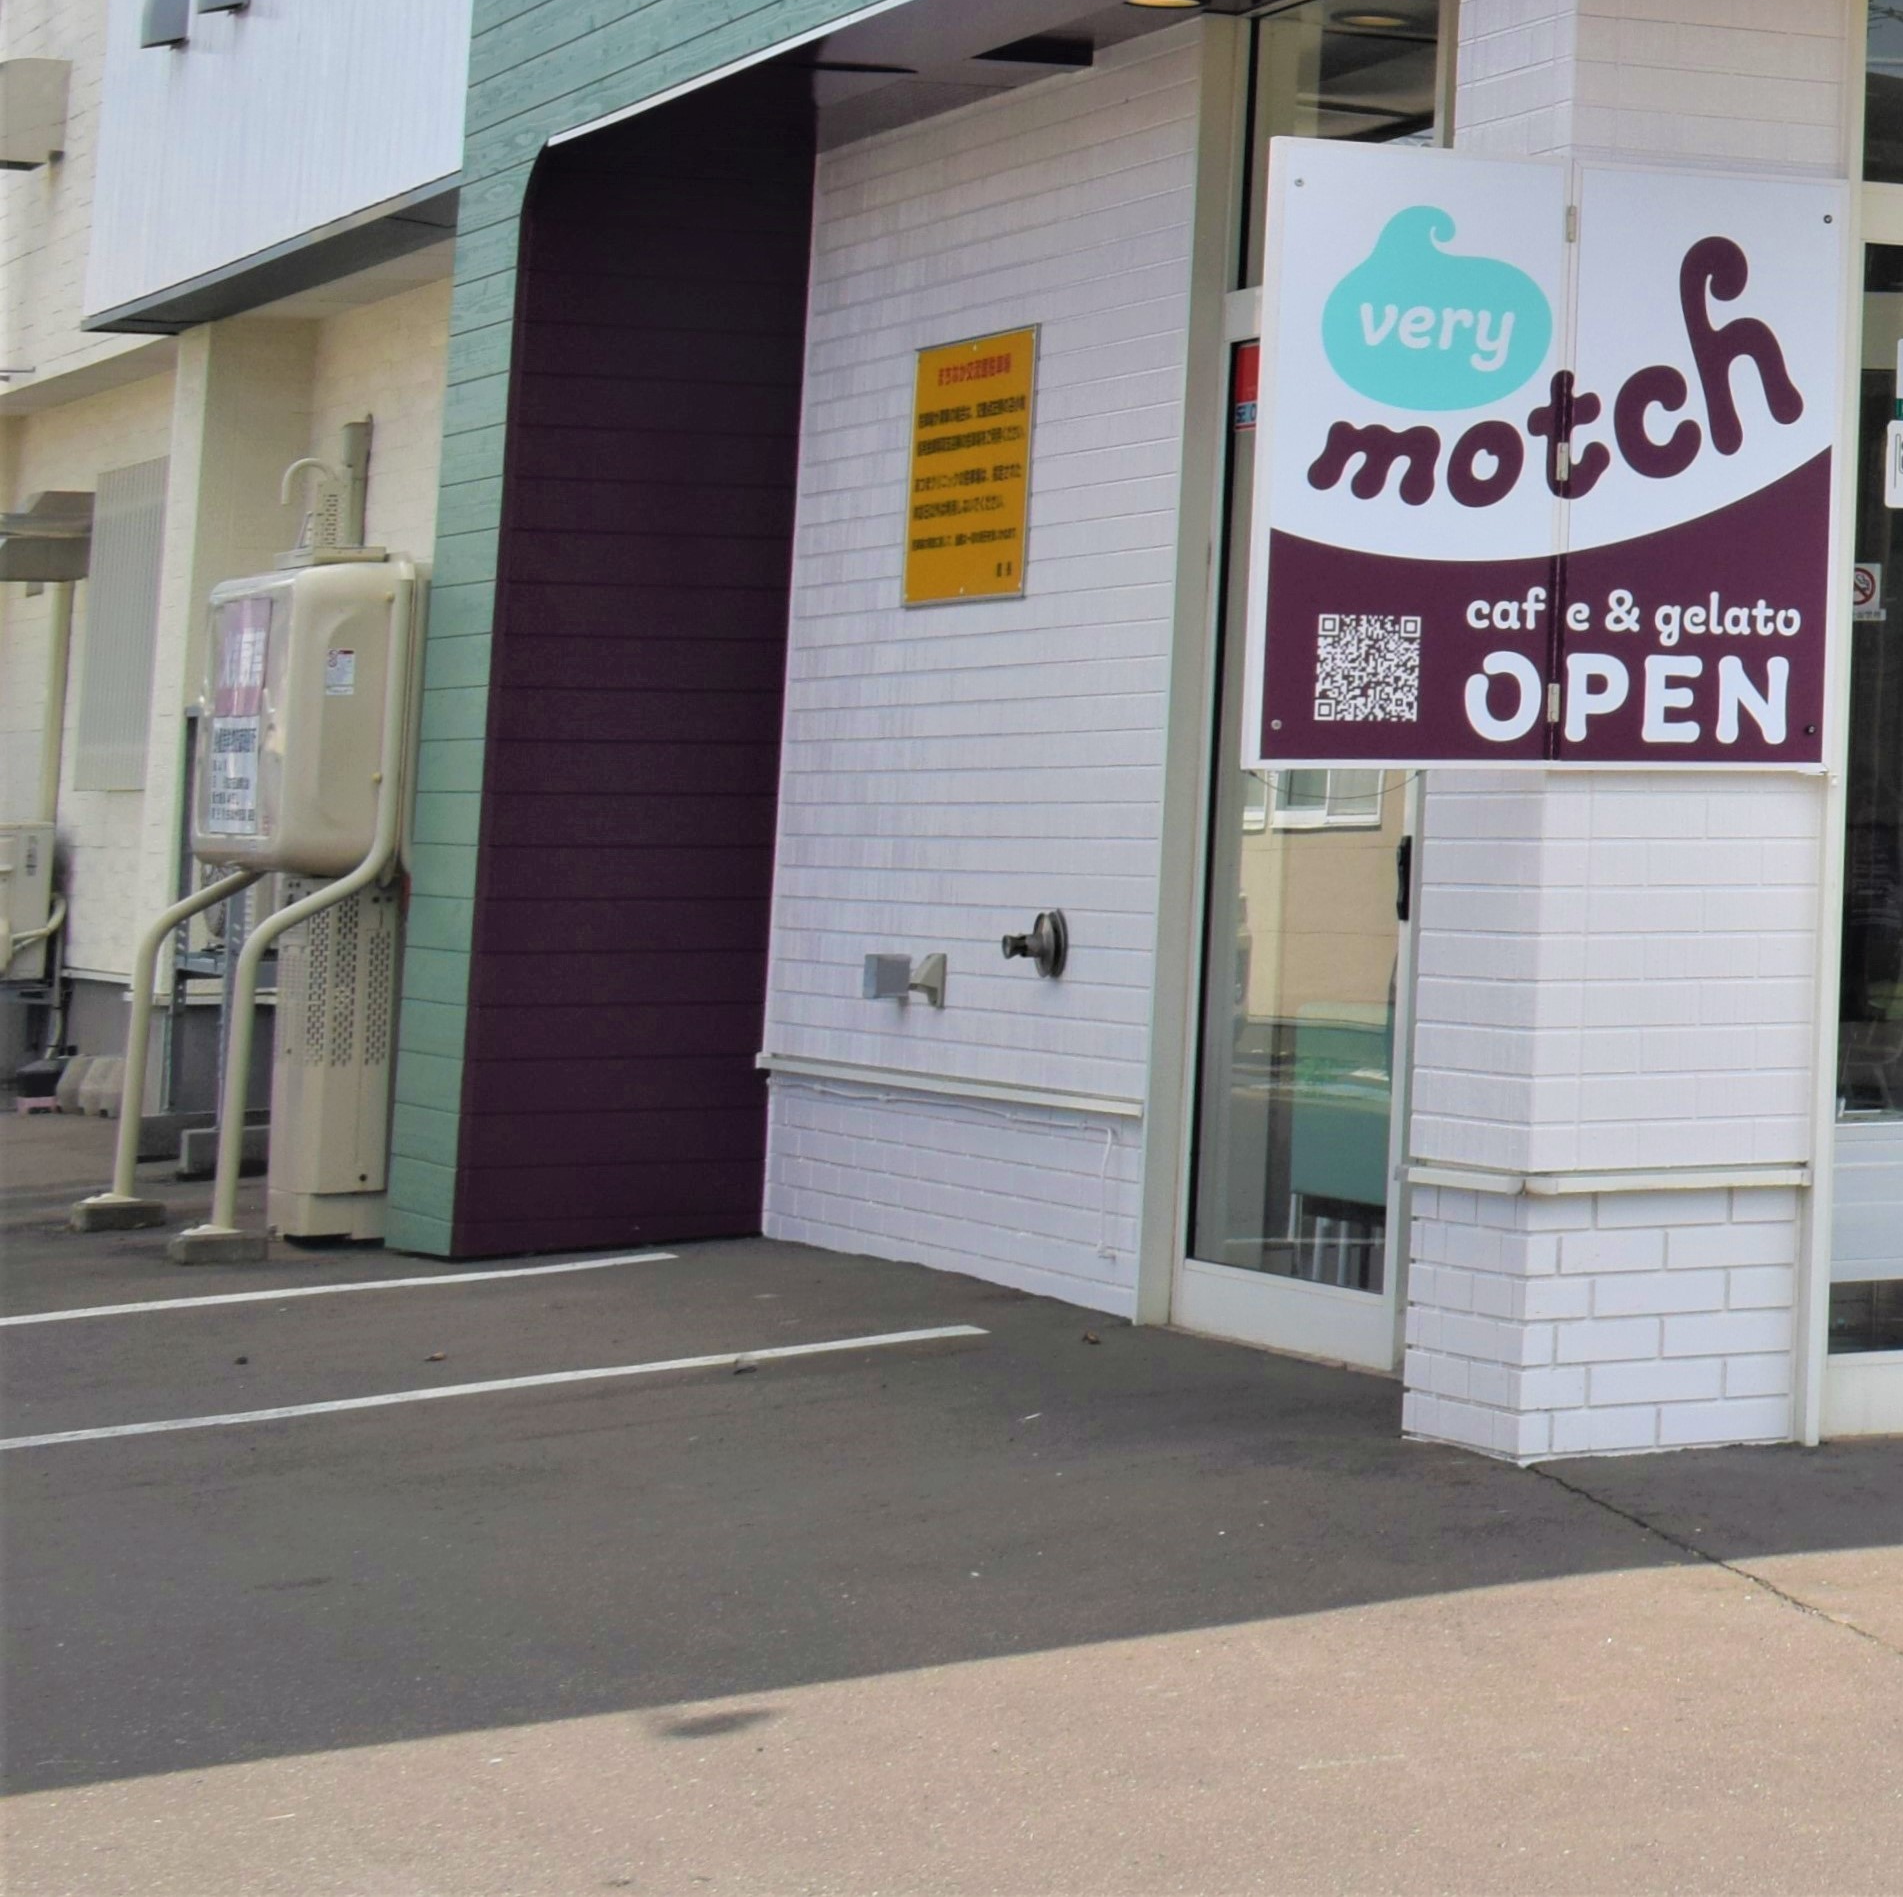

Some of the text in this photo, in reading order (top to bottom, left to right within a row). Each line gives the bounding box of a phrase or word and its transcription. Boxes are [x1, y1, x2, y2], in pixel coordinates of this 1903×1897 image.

[1307, 236, 1804, 508] motch
[1360, 302, 1516, 372] very
[1604, 589, 1641, 632] &
[1654, 591, 1802, 647] gelato
[1464, 650, 1790, 745] OPEN
